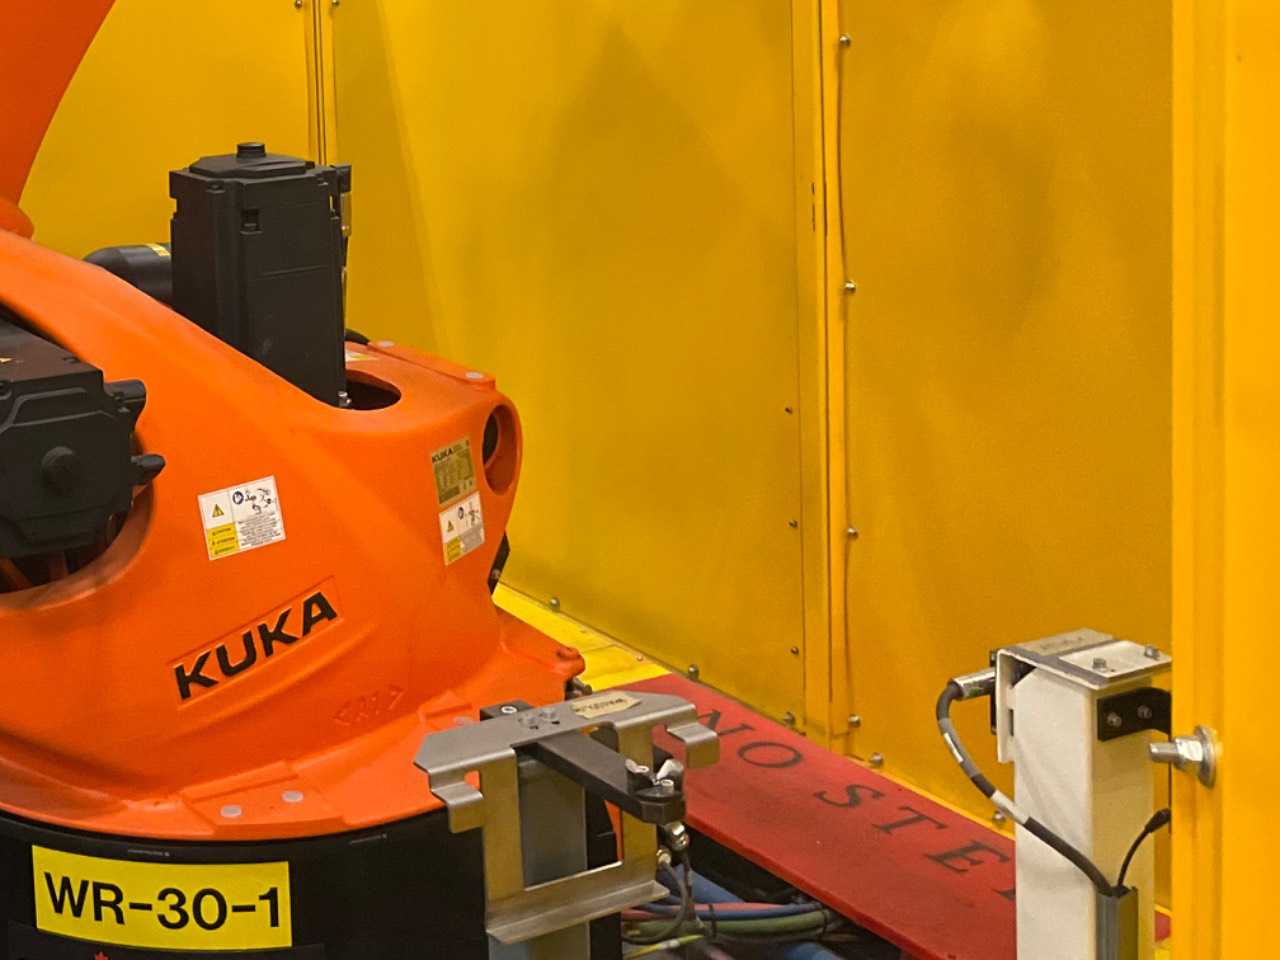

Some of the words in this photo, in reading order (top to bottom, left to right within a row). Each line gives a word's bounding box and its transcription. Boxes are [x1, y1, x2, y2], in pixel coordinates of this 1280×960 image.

[174, 591, 338, 701] KUKA
[813, 783, 1016, 900] STE
[43, 871, 280, 931] WR-30-1
